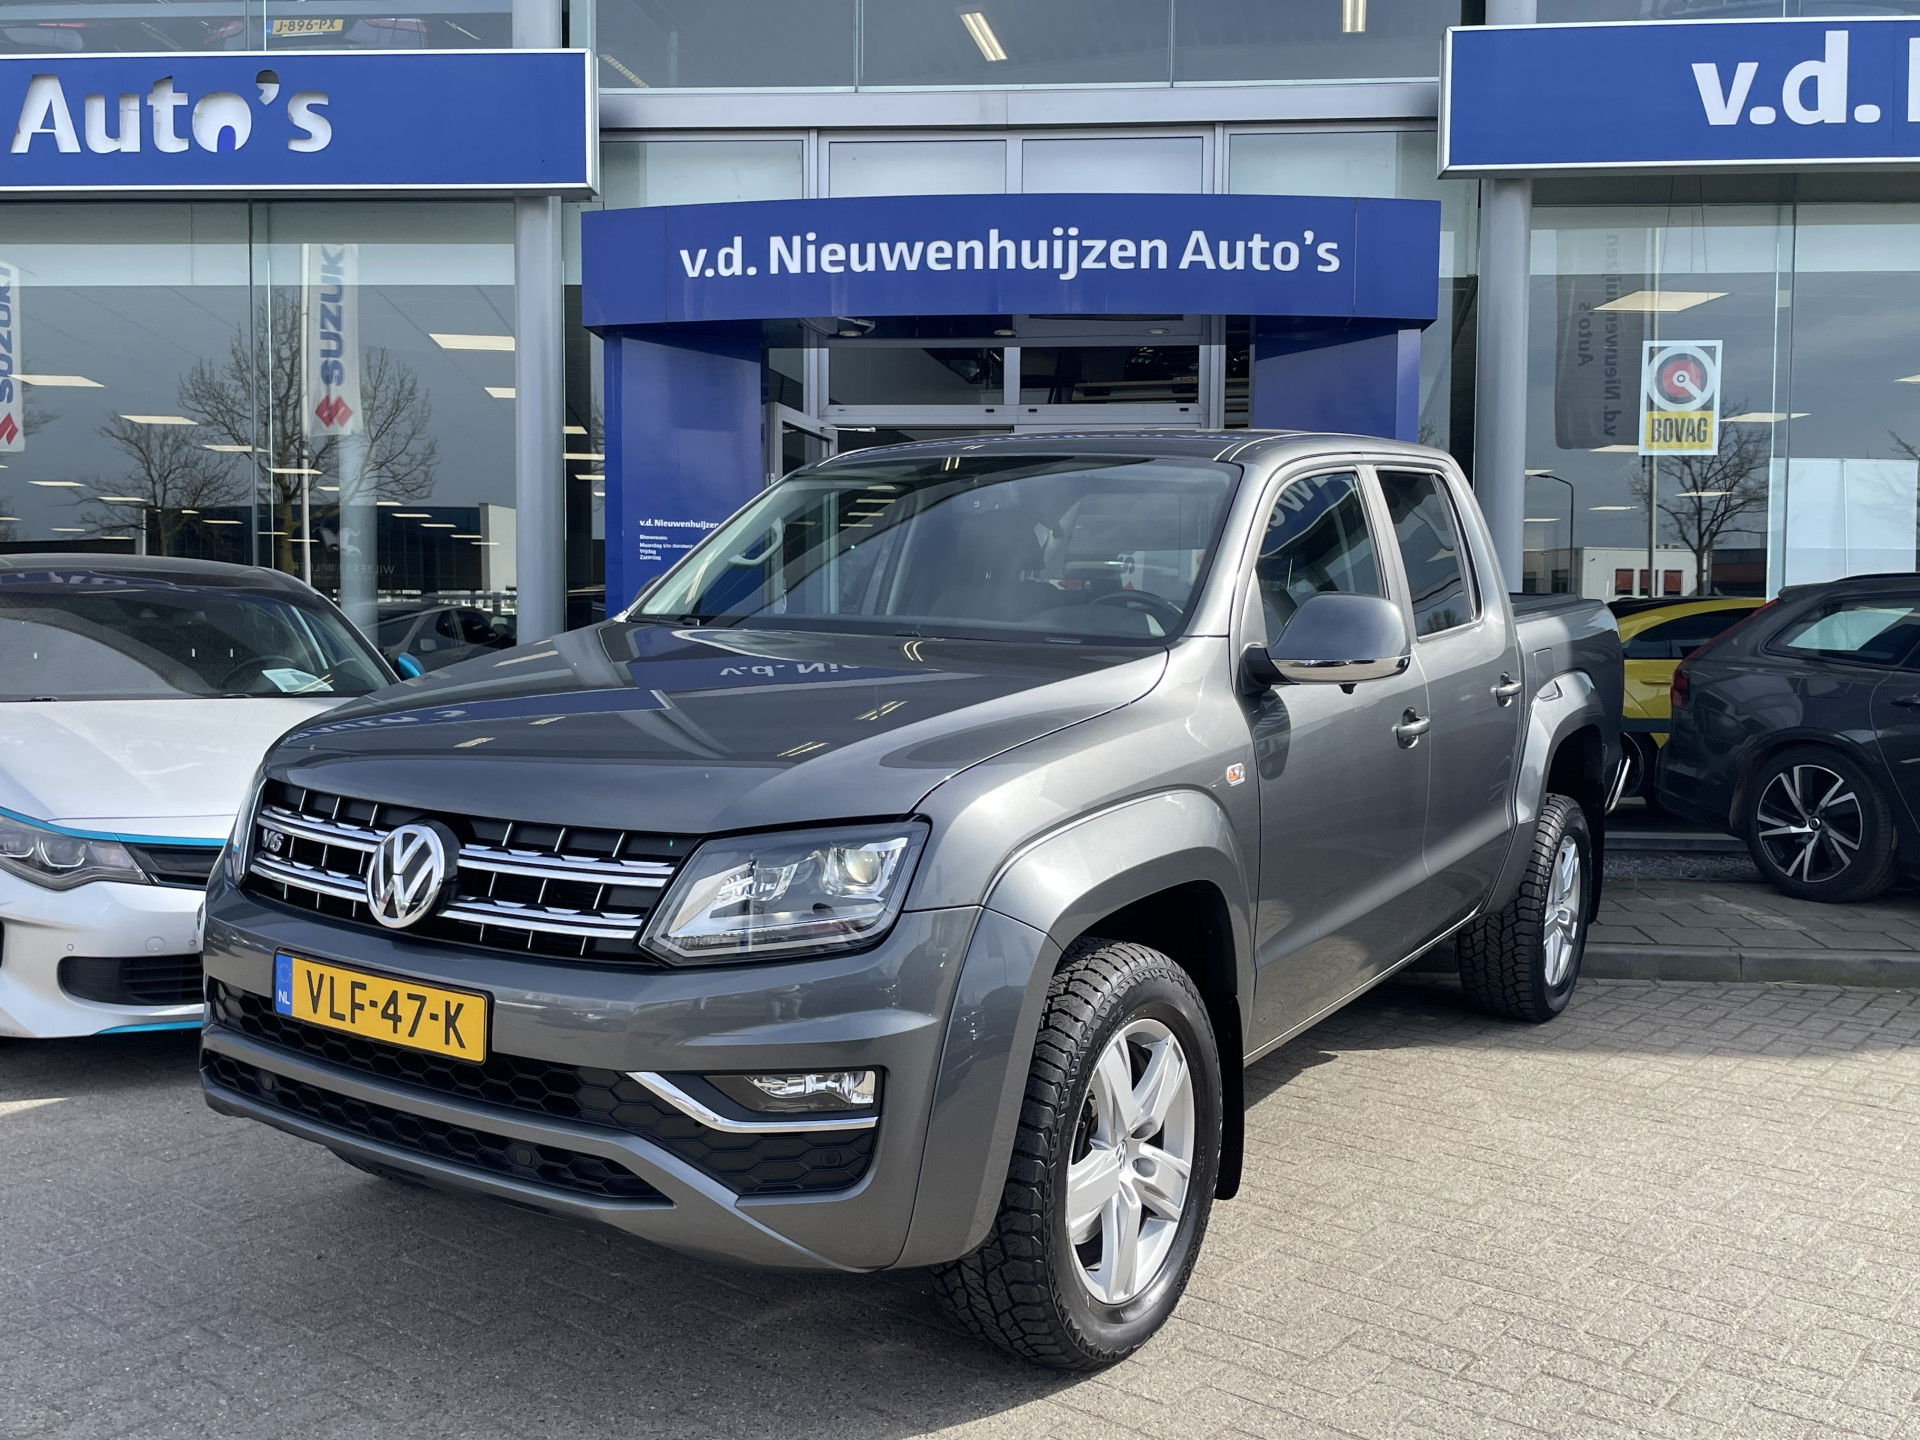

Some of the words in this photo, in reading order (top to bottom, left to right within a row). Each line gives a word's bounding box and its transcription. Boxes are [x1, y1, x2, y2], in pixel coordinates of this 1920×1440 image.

[275, 20, 336, 33] J-896-PX
[1691, 30, 1881, 126] v.d.
[10, 69, 333, 154] Auto's
[679, 236, 758, 278] v.d.
[769, 227, 1168, 281] Nieuwenhuijzen
[1178, 230, 1340, 273] Auto's
[1650, 417, 1709, 443] BOVAG
[639, 518, 654, 527] v.d.
[262, 828, 285, 853] V6
[277, 989, 291, 1005] NL
[305, 969, 467, 1050] VLF-47-K
